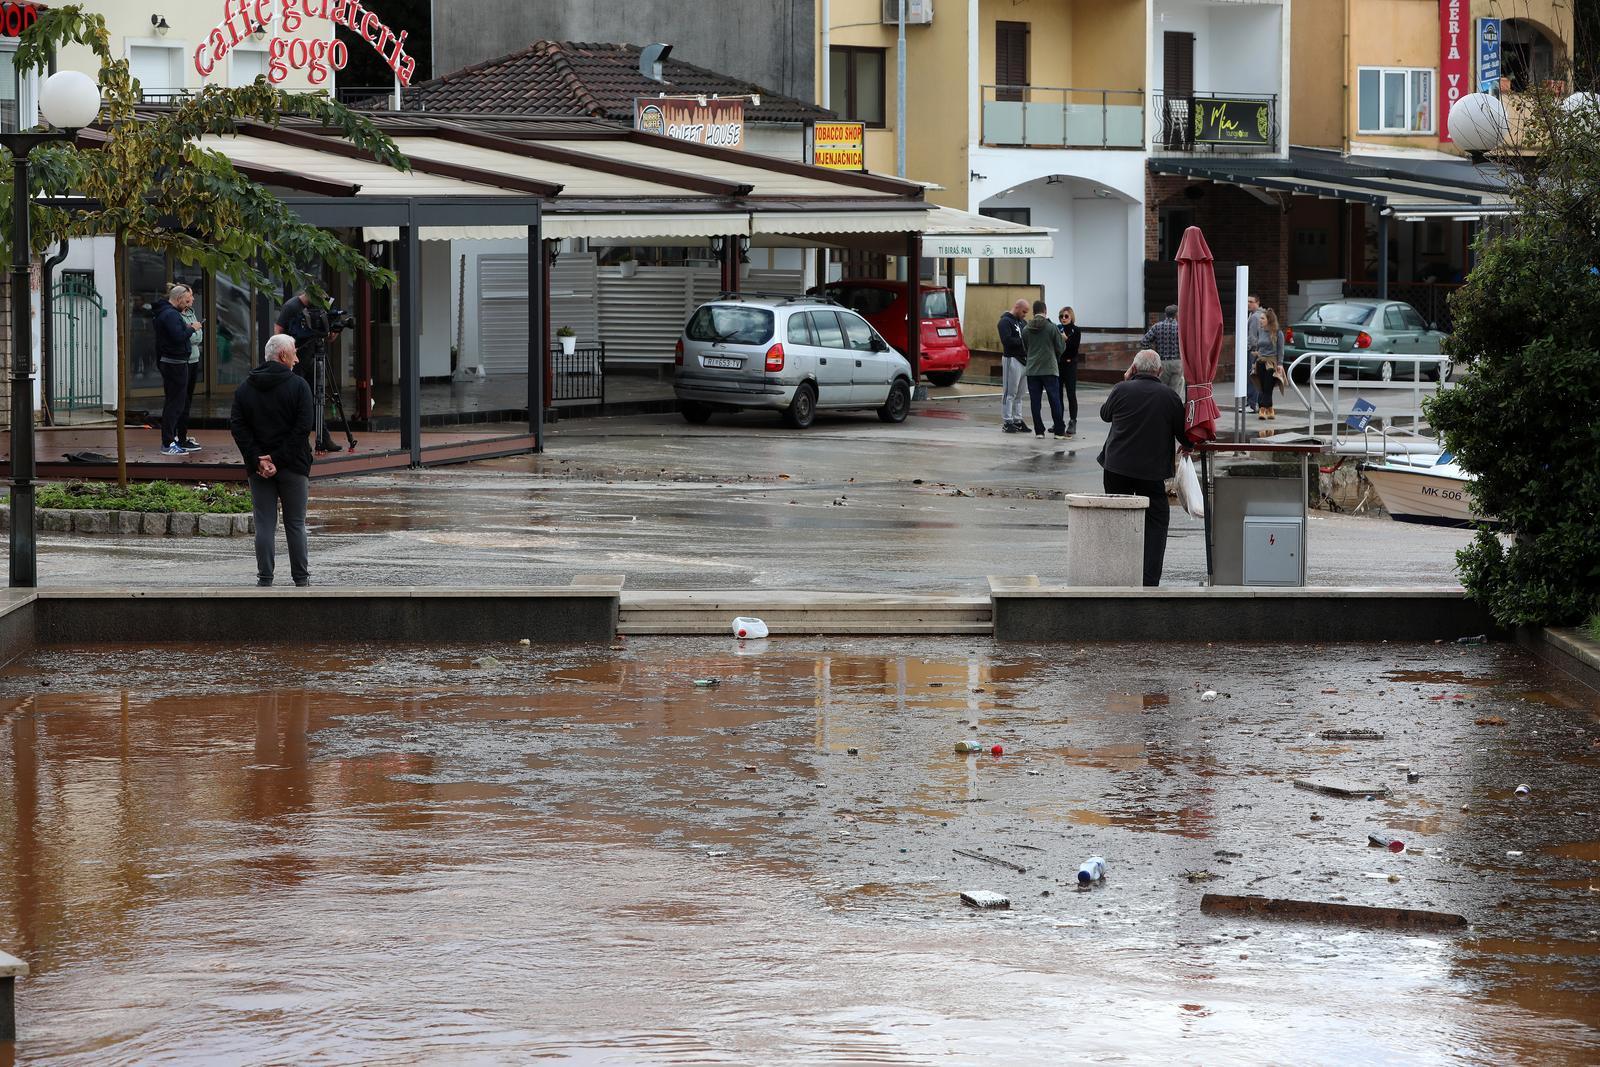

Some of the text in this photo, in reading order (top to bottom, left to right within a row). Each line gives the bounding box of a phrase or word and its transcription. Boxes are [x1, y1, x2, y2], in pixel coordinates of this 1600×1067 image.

[268, 37, 348, 84] gogo
[815, 127, 862, 140] TOBACCO SHOP
[1210, 103, 1239, 140] Mia
[706, 122, 741, 146] HOUSE
[1421, 486, 1462, 501] MK 506
